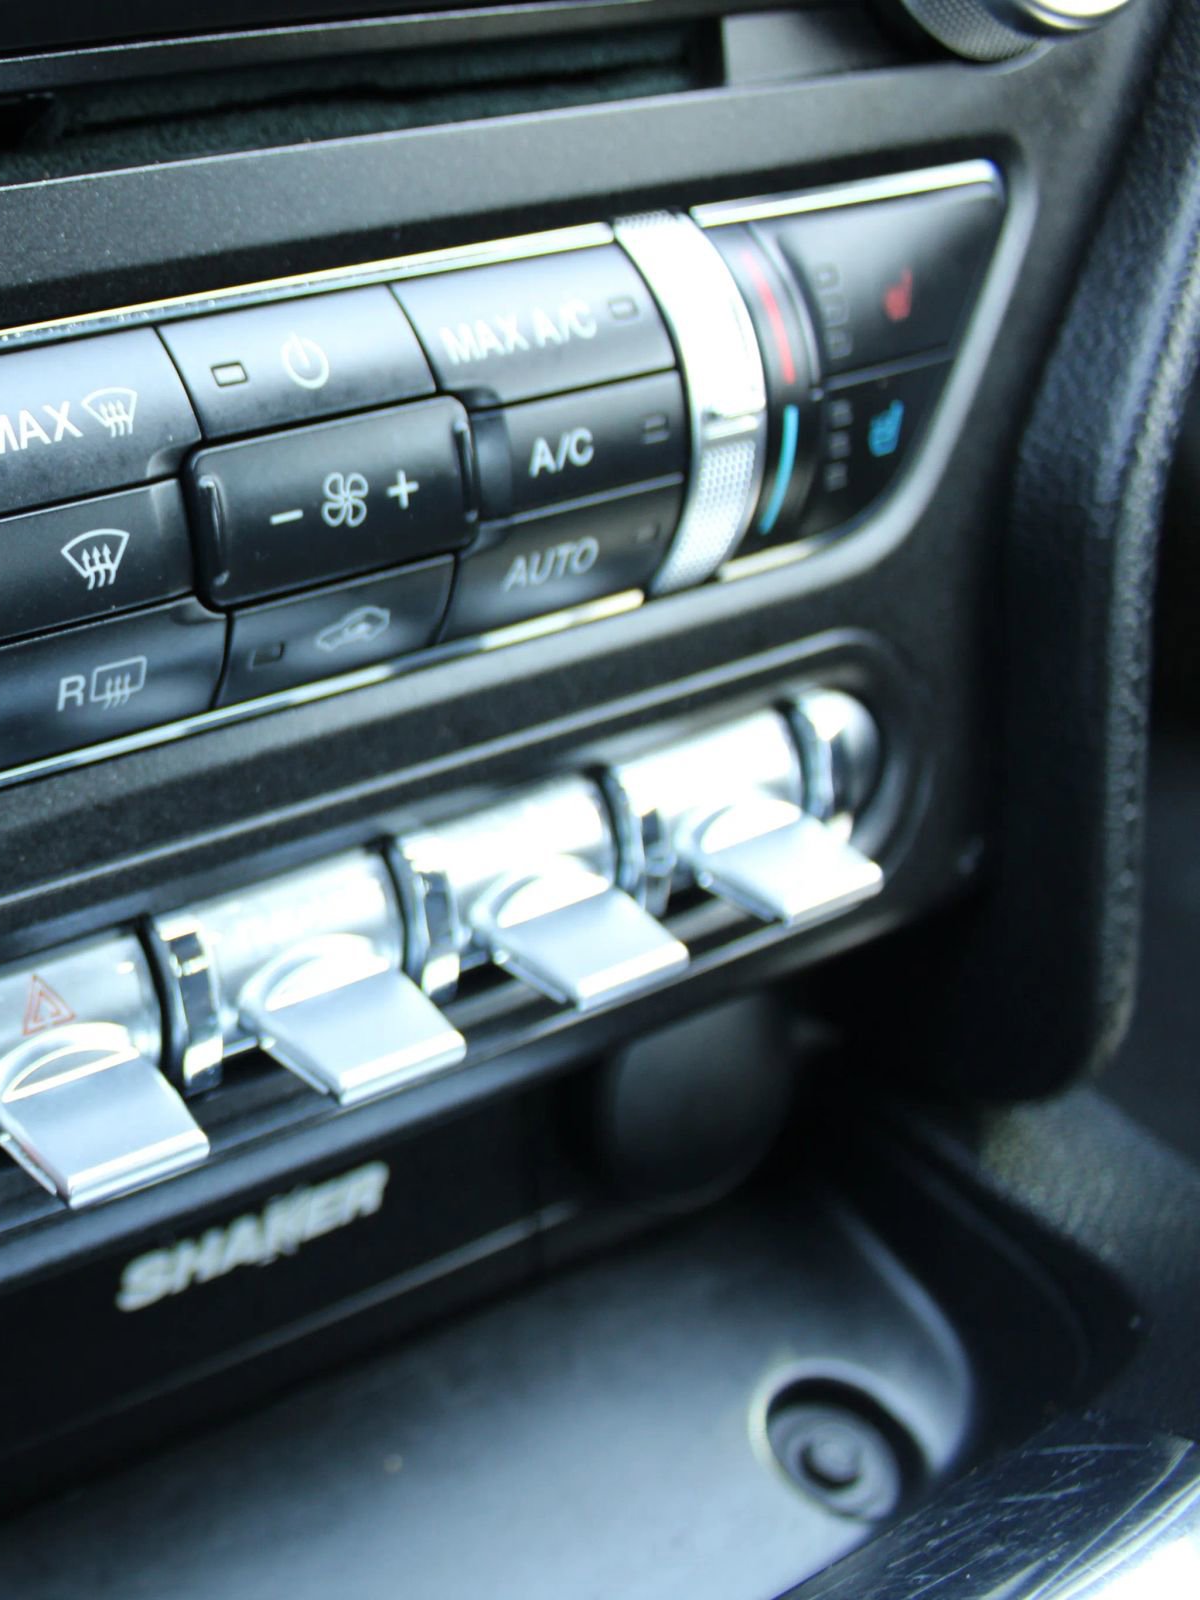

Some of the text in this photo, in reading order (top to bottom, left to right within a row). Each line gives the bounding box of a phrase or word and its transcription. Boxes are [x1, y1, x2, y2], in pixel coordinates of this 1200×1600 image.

[439, 299, 598, 365] MAX A/C
[529, 427, 594, 479] A/C
[503, 537, 599, 592] AUTO
[57, 675, 84, 711] R
